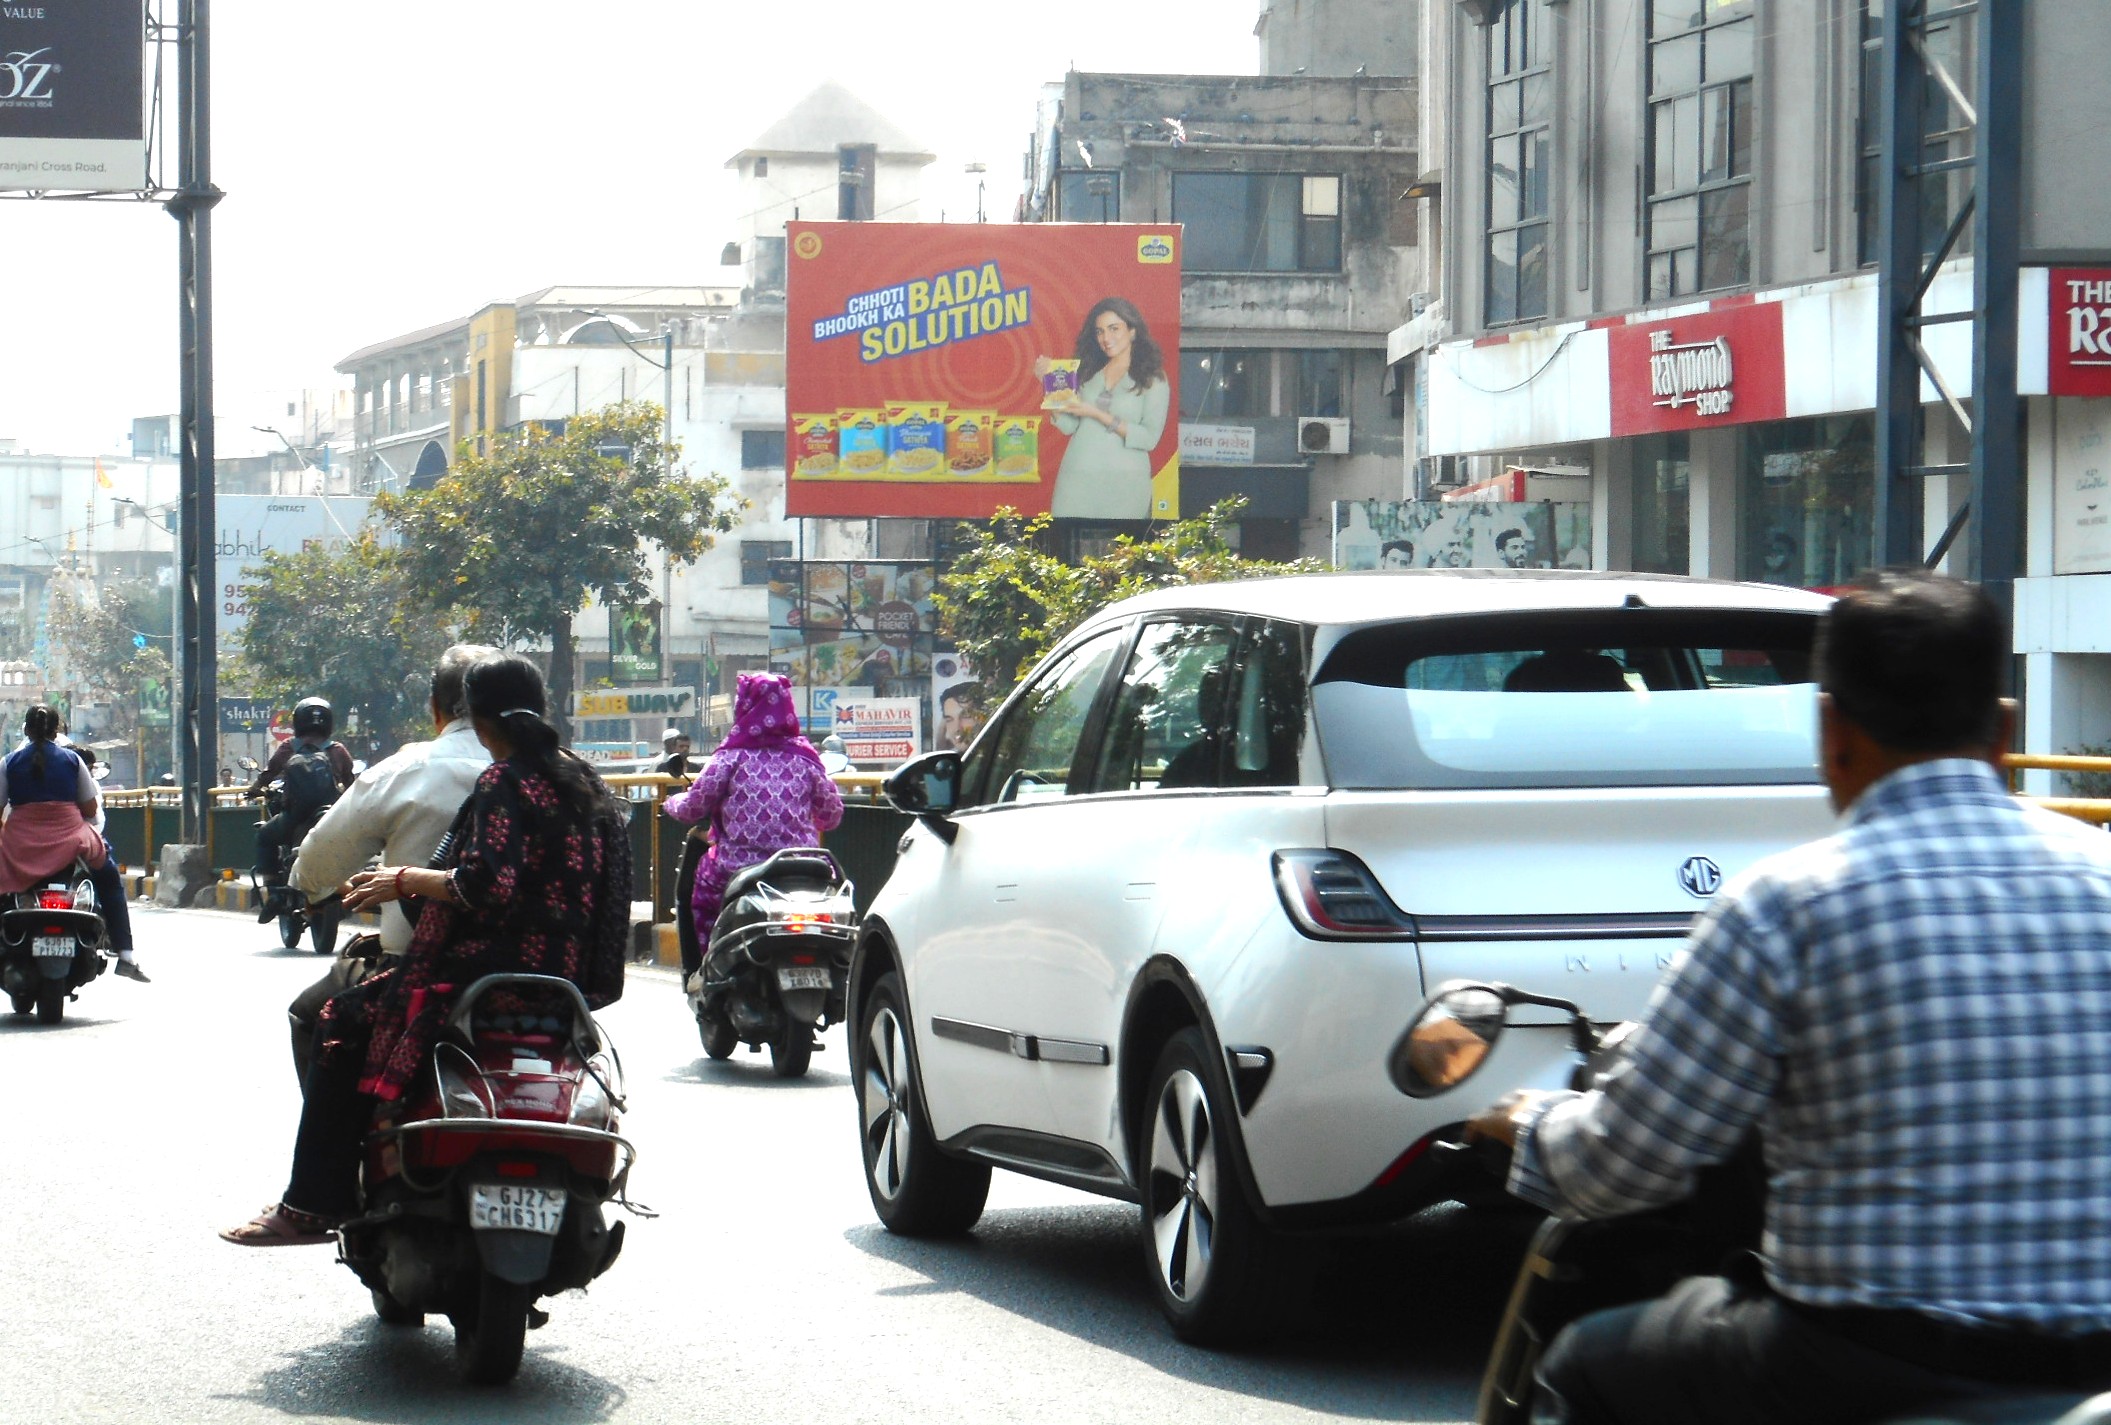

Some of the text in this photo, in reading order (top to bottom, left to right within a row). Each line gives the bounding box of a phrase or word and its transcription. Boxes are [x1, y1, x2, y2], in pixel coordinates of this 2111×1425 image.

[3, 7, 45, 19] VALUE
[42, 161, 72, 172] Cross
[908, 263, 1001, 315] BADA
[849, 286, 904, 314] CHHOTI
[814, 303, 905, 339] BHOOKH KA
[861, 290, 1028, 361] SOLUTION
[1696, 390, 1734, 416] SHOP
[267, 504, 306, 513] CONTACT
[878, 612, 914, 621] POCKET
[635, 662, 657, 670] GOLD
[226, 706, 271, 719] shakti
[577, 692, 691, 717] SUBWAY
[856, 709, 911, 720] MAHAVIR
[848, 743, 908, 757] URIER SERVICE
[1681, 857, 1721, 897] MG
[500, 1187, 546, 1208] GJ27
[488, 1206, 559, 1232] CH6317
